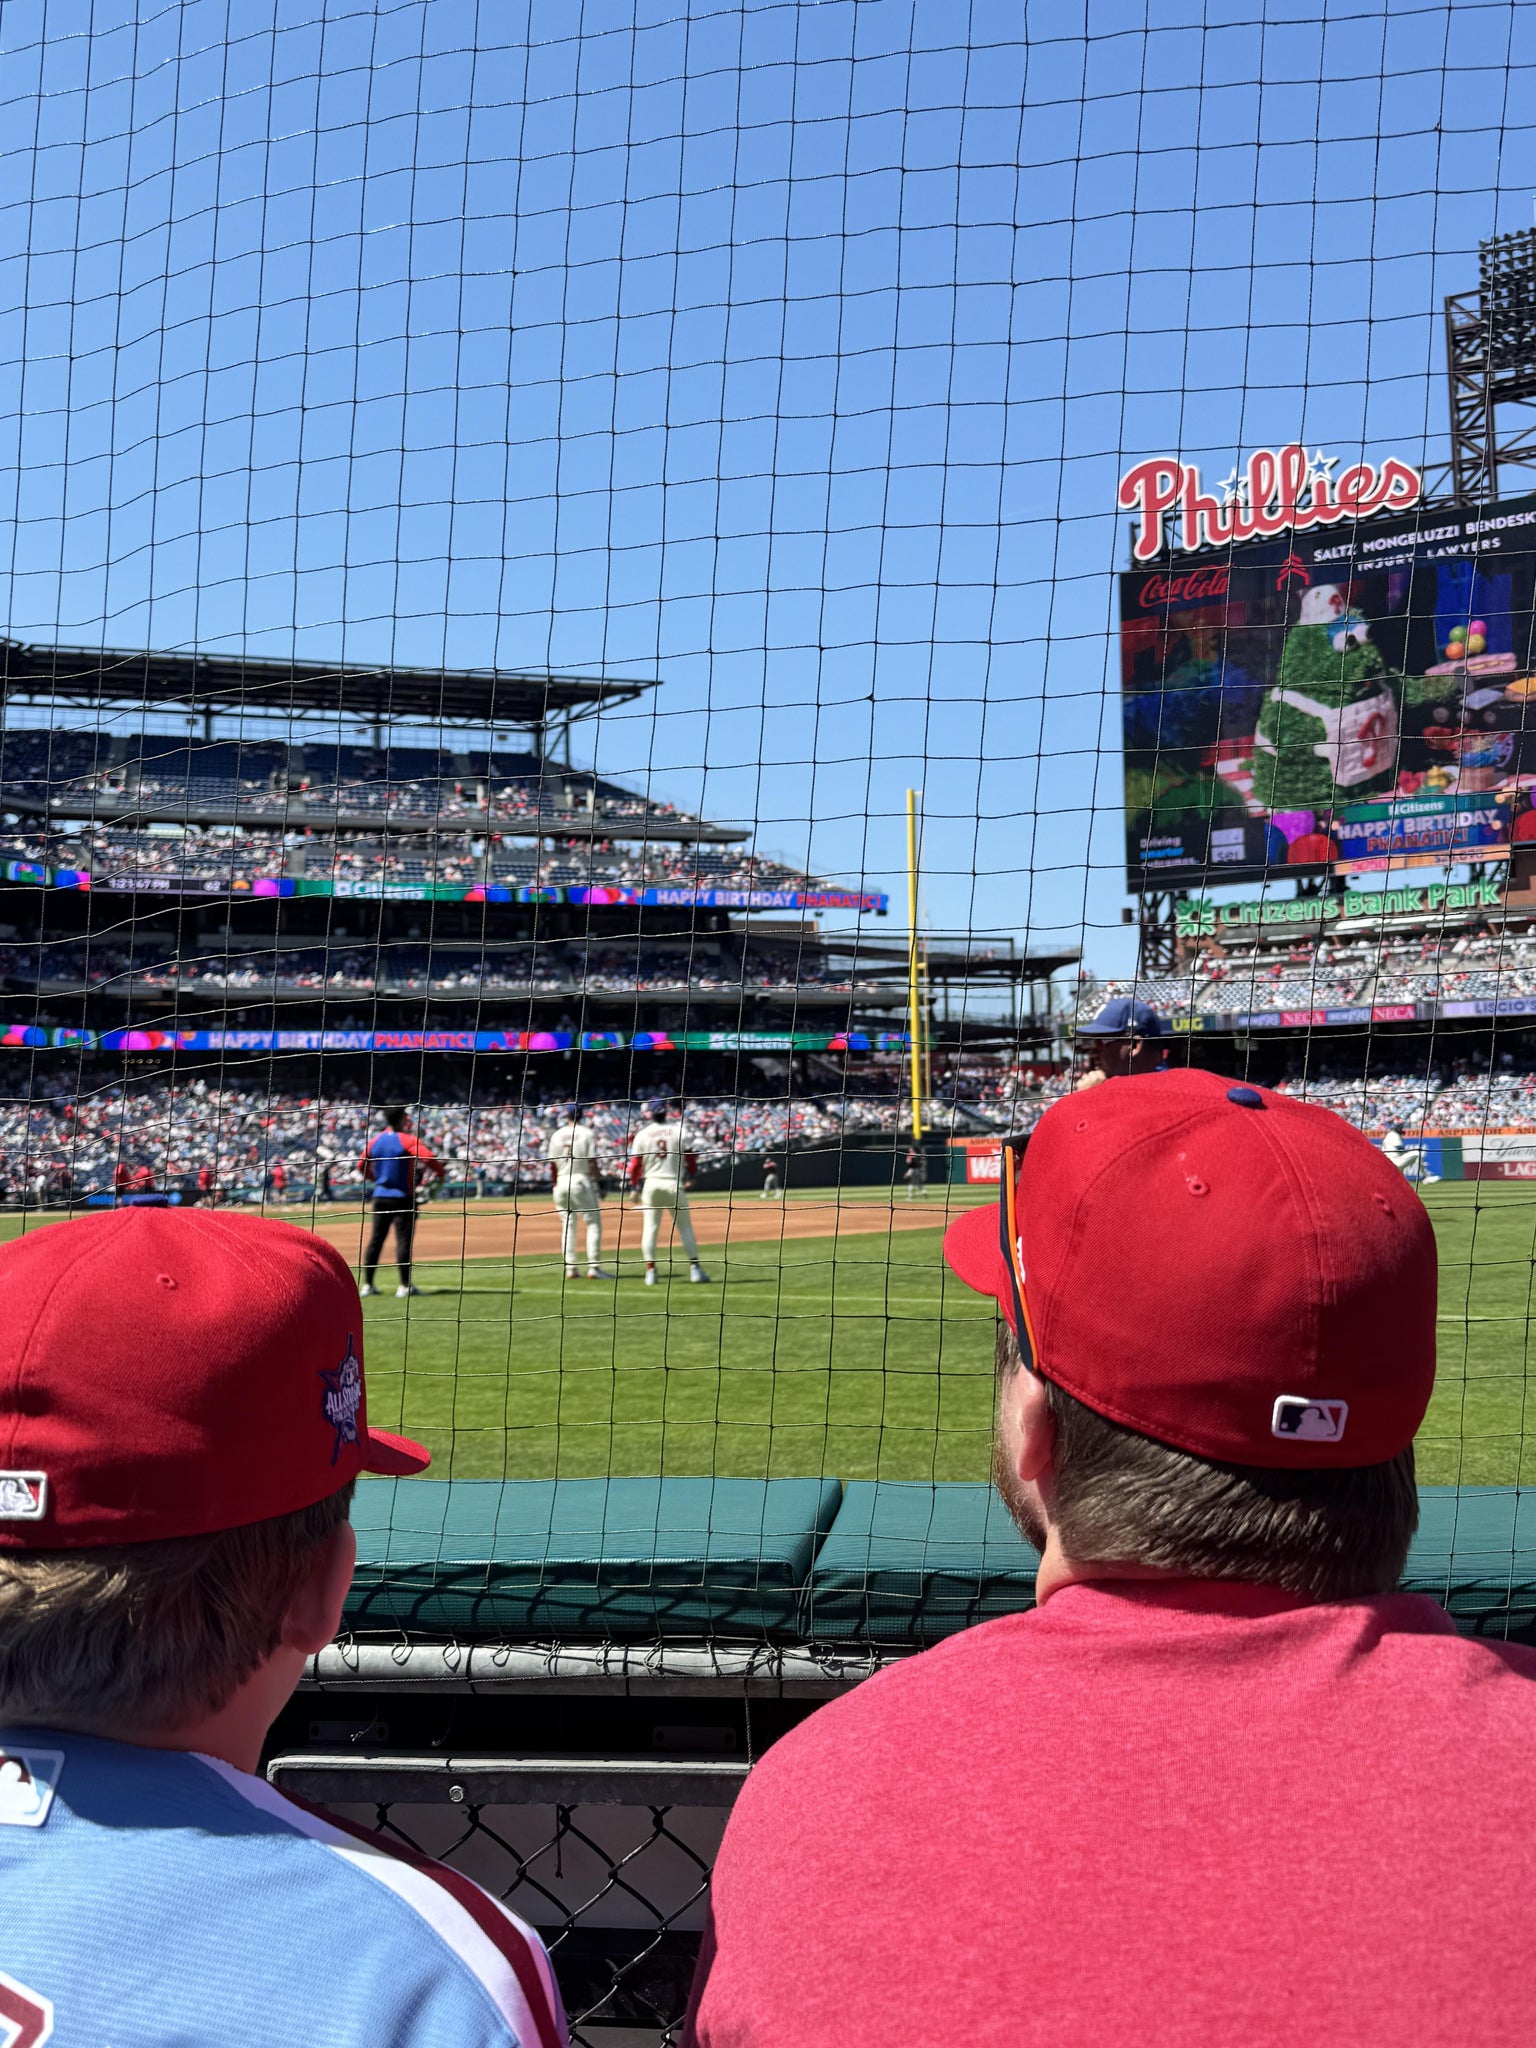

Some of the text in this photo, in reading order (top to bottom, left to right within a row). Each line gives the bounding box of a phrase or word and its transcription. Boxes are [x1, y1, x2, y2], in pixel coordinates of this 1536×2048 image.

[1118, 442, 1421, 561] Phillies
[1314, 544, 1357, 562] SALTZ
[1363, 525, 1460, 553] MONGELUZZI
[1358, 537, 1501, 571] INJURY LAWYERS
[1400, 802, 1444, 815] Citizens
[1338, 809, 1498, 840] HAPPY BIRTHDAY
[657, 890, 710, 905] HAPPY
[714, 891, 792, 907] BIRTHDAY
[1220, 876, 1501, 927] Citizens Bank Park
[1282, 1011, 1325, 1026] NECA
[1373, 1005, 1415, 1021] NECA
[208, 1032, 474, 1049] HAPPY BIRTHDAY PHANATIC!
